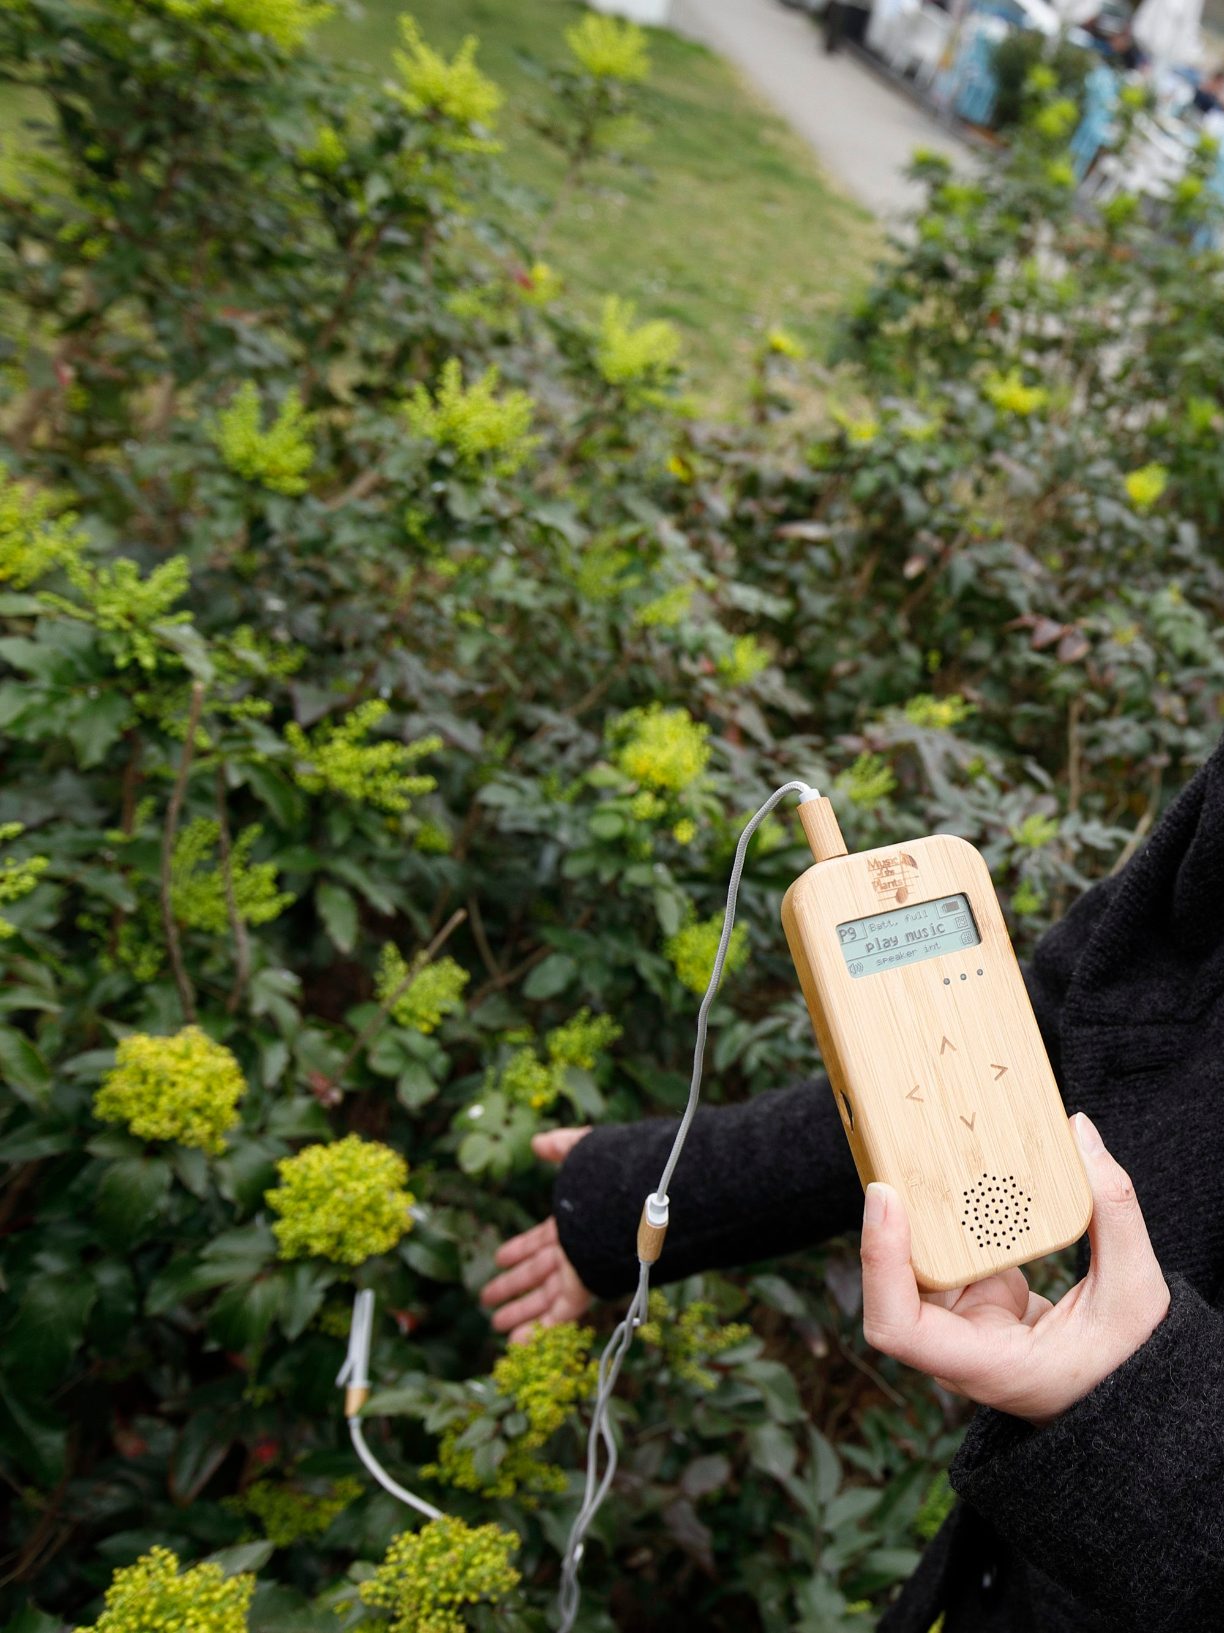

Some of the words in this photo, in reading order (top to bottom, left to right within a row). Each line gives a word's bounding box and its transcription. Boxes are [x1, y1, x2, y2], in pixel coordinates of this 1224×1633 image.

[867, 857, 900, 869] Music
[871, 878, 904, 892] Plants
[905, 909, 928, 922] full
[866, 935, 899, 953] play
[906, 922, 945, 943] music
[876, 949, 916, 966] speaker
[924, 942, 941, 953] int
